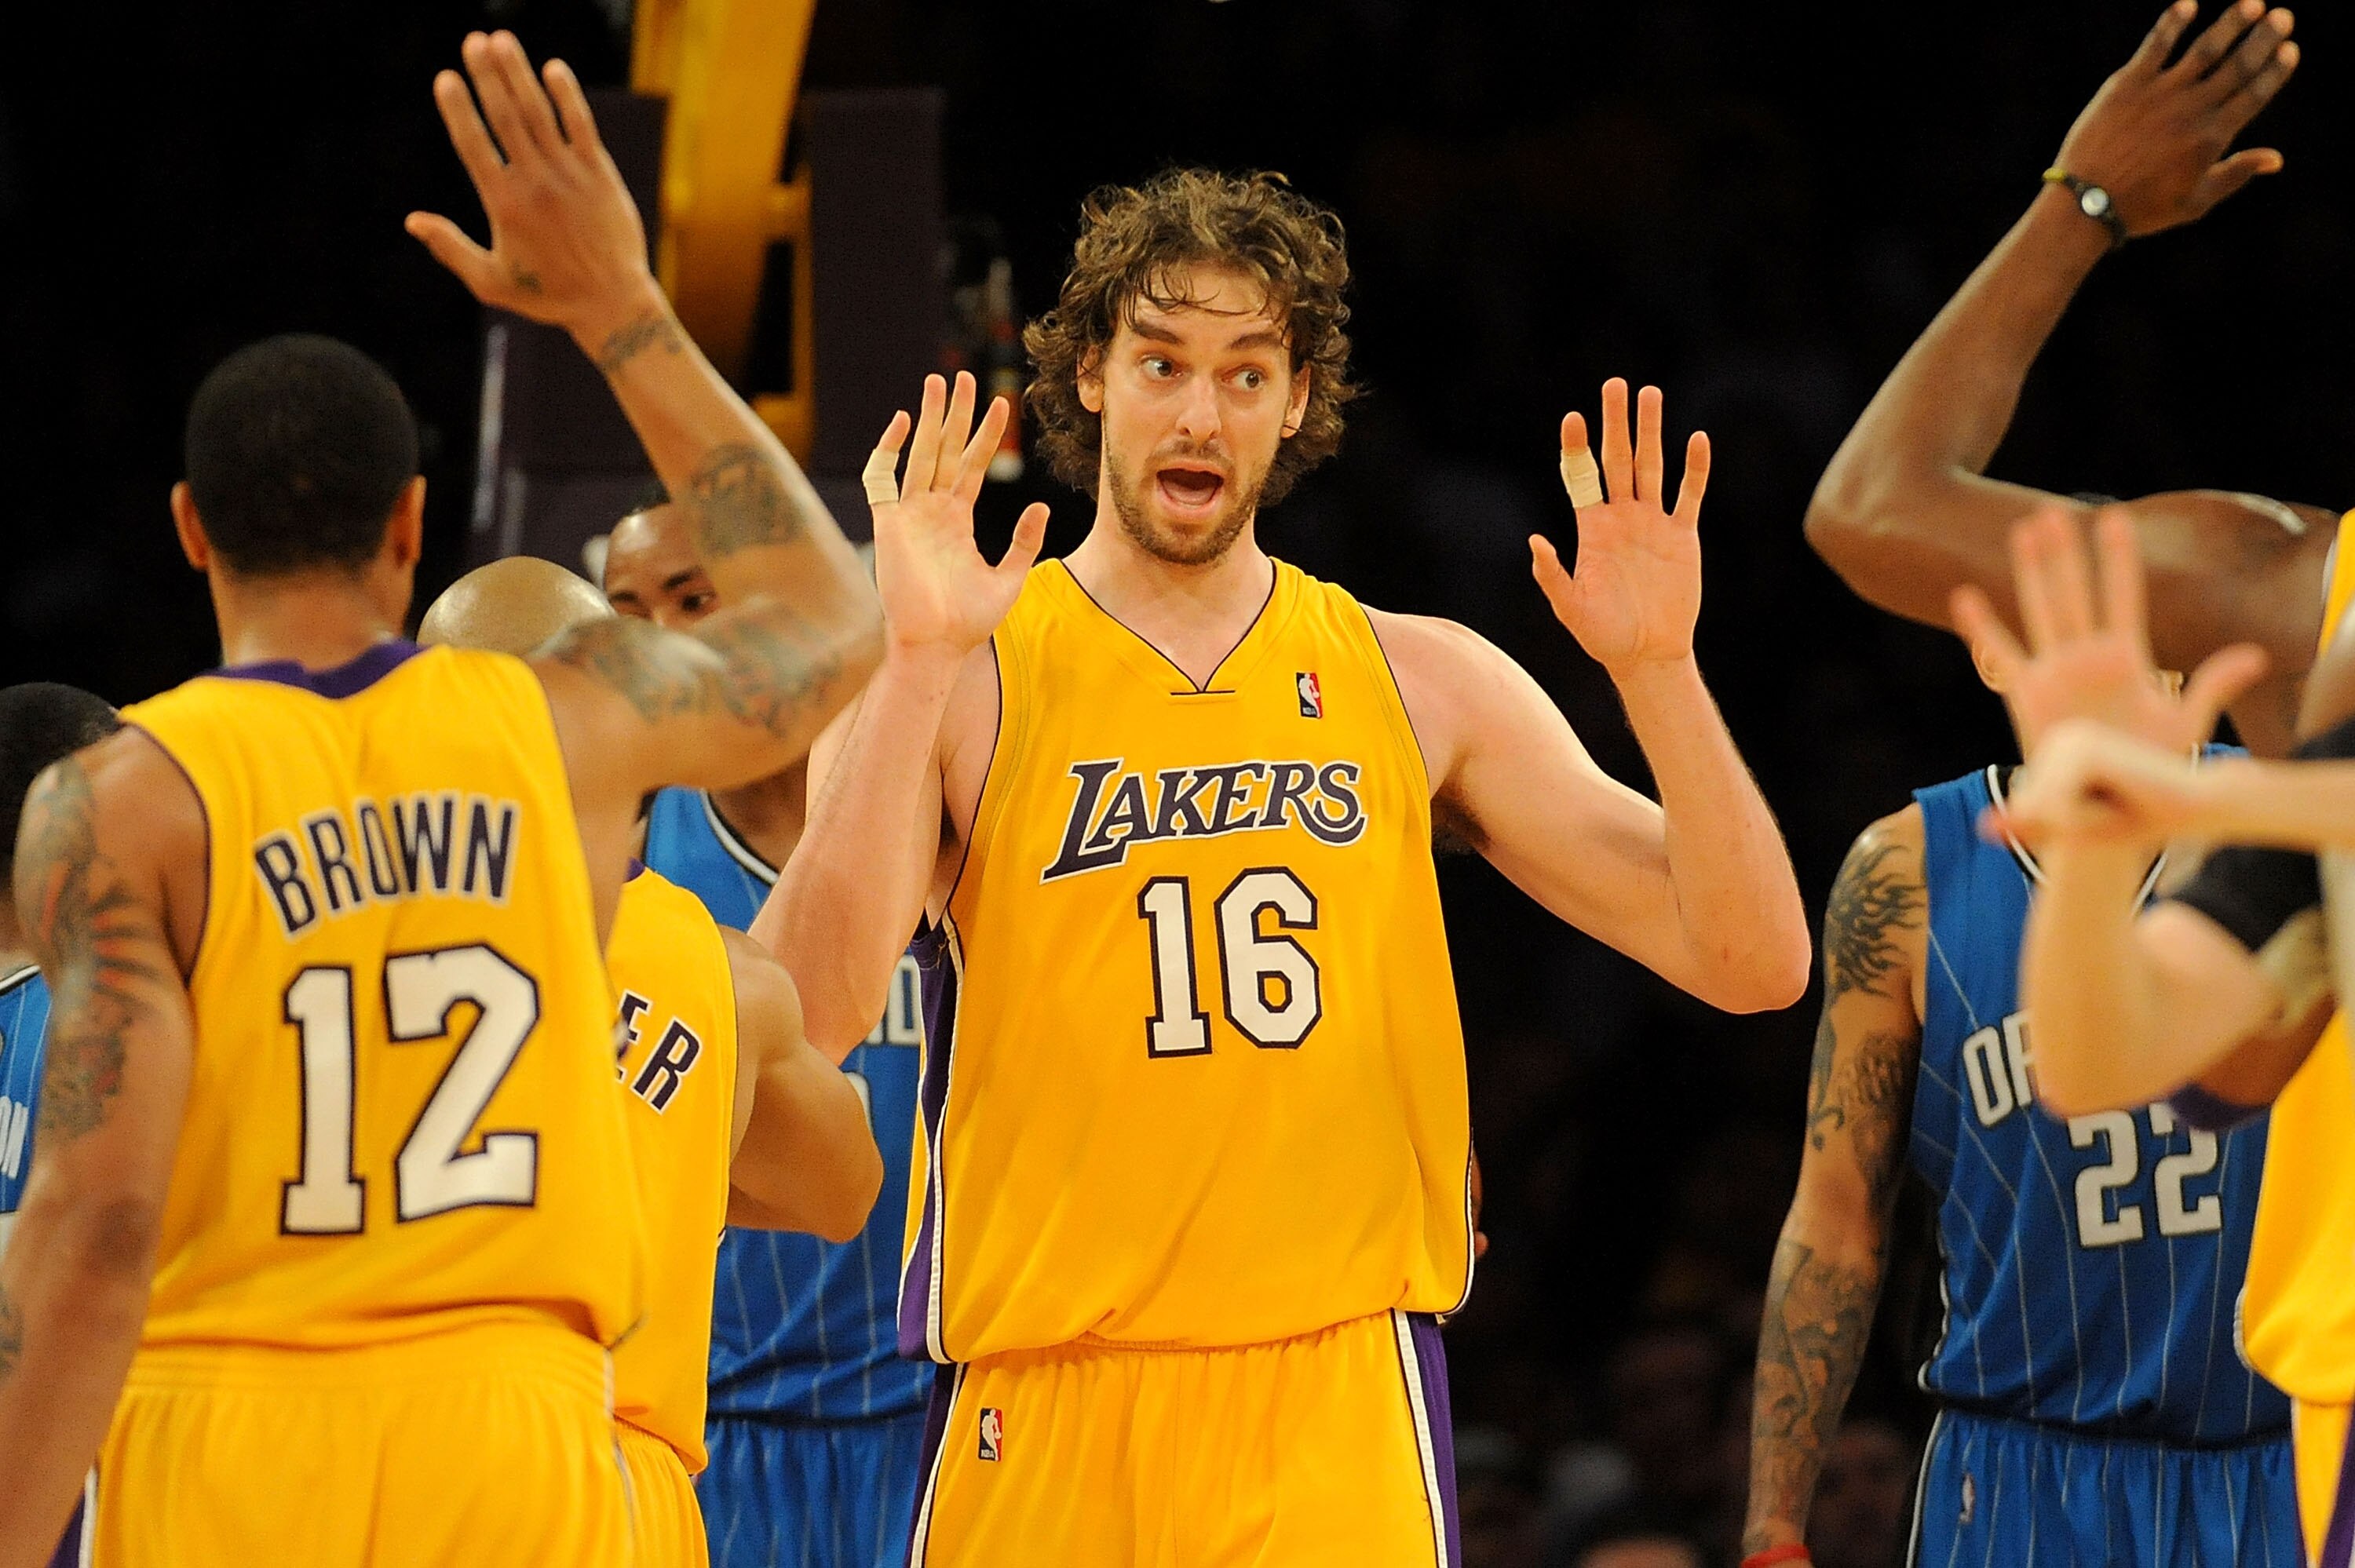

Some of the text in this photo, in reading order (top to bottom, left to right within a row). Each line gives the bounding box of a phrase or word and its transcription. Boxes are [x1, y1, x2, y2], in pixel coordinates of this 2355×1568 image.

[254, 793, 520, 939] BROWN
[1039, 757, 1368, 885] LAKERS
[1137, 866, 1323, 1058] 16
[280, 943, 540, 1236] 12
[2067, 1101, 2222, 1247] 22
